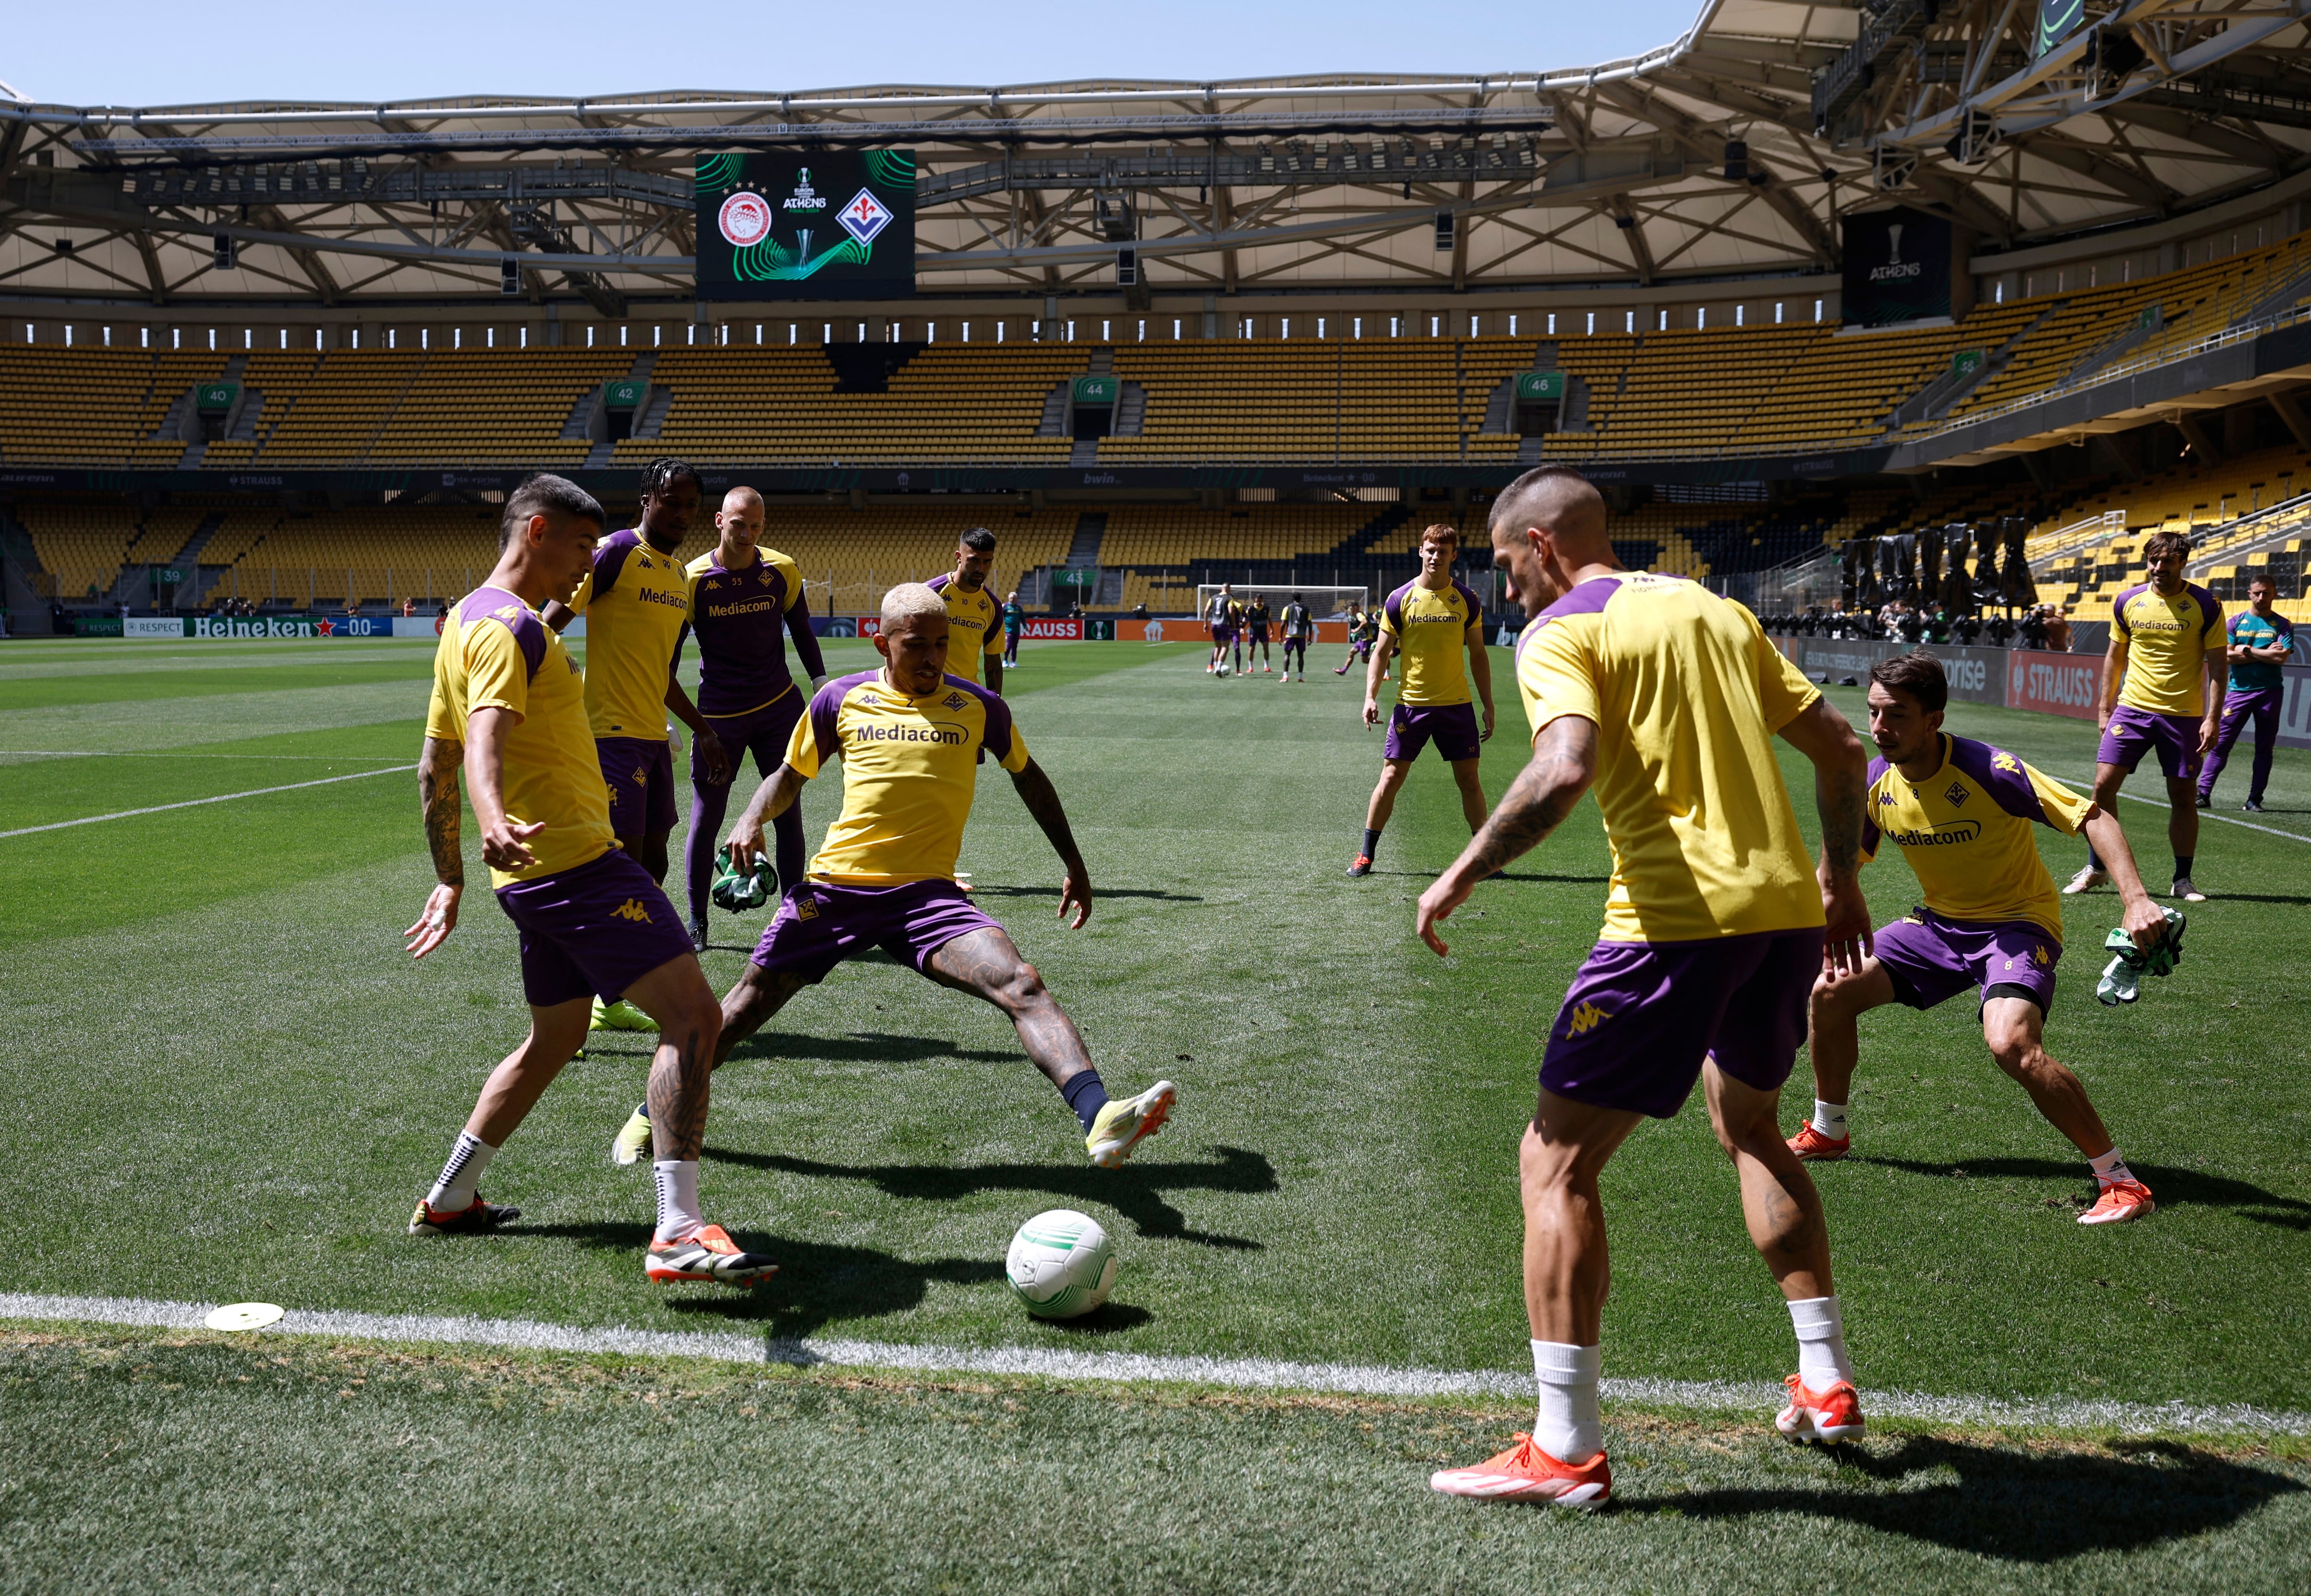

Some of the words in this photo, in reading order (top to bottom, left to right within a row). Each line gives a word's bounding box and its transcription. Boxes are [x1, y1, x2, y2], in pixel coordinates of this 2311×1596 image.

[783, 197, 826, 208] ATHENS
[1869, 262, 1920, 281] ATHENS
[1087, 384, 1103, 395] 44
[1532, 379, 1549, 391] 46
[210, 391, 226, 402] 40
[618, 388, 633, 399] 42
[240, 476, 282, 485] STRAUSS
[702, 476, 728, 485] quote
[1084, 472, 1115, 483] bwin
[662, 559, 670, 569] 99
[164, 570, 180, 581] 39
[1066, 573, 1083, 584] 43
[639, 587, 687, 610] Mediacom
[709, 601, 770, 617] Mediacom
[948, 615, 982, 630] ediacom
[1408, 614, 1457, 623] Mediacom
[140, 623, 181, 632] RESPECT
[195, 618, 312, 637] Heineken
[1020, 623, 1077, 637] RAUSS
[2132, 620, 2183, 631] Mediacom
[1942, 648, 1986, 691] prise
[2028, 663, 2094, 708] STRAUSS
[906, 699, 914, 707] 2
[857, 724, 960, 745] Mediacom
[1913, 788, 1919, 800] 8
[1884, 829, 1973, 846] Mediacom
[2005, 960, 2012, 970] 8
